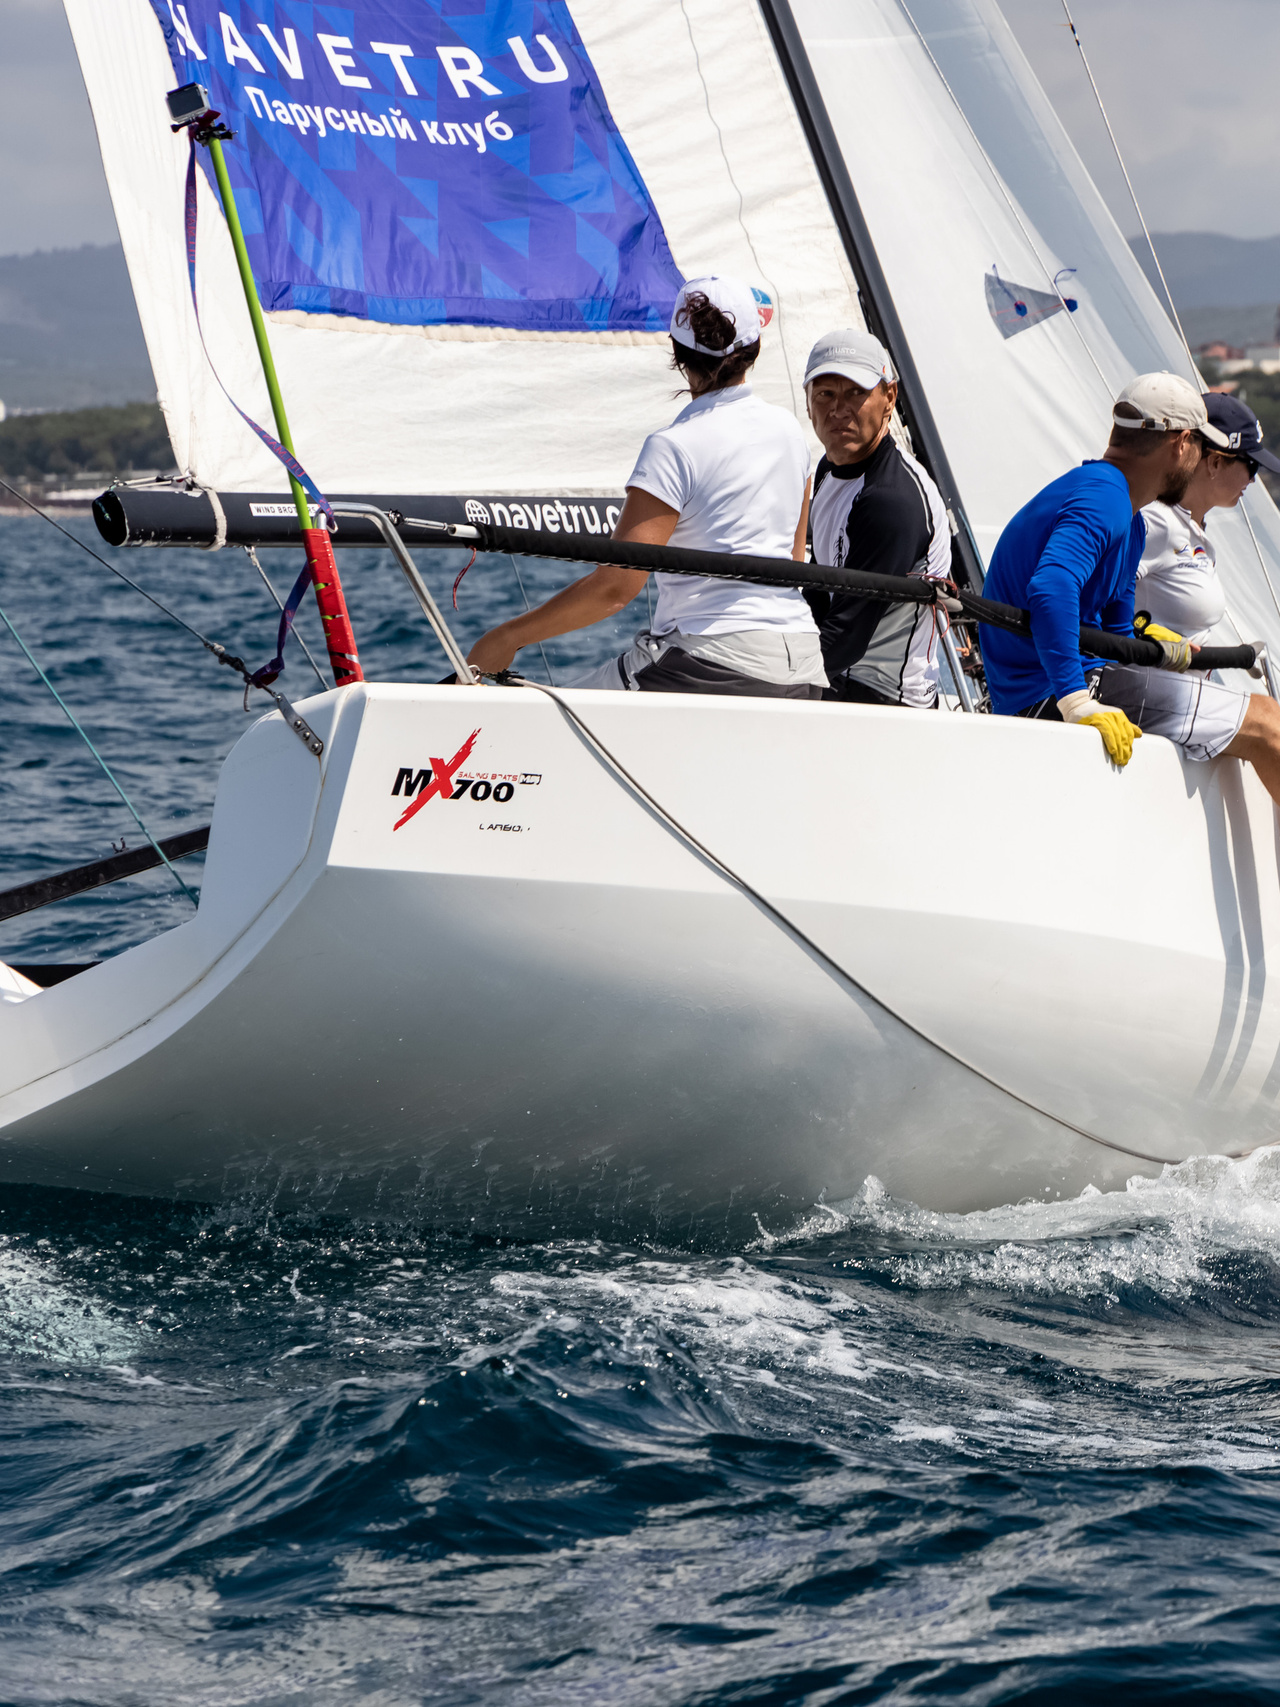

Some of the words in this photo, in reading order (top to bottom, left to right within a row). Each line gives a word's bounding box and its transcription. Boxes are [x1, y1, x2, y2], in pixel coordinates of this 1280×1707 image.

[166, 0, 569, 99] NAVETRU
[244, 85, 418, 142] Парусный
[420, 110, 514, 154] клуб
[1228, 431, 1242, 449] FJ
[254, 506, 276, 514] WIND
[277, 506, 316, 514] BROTRS
